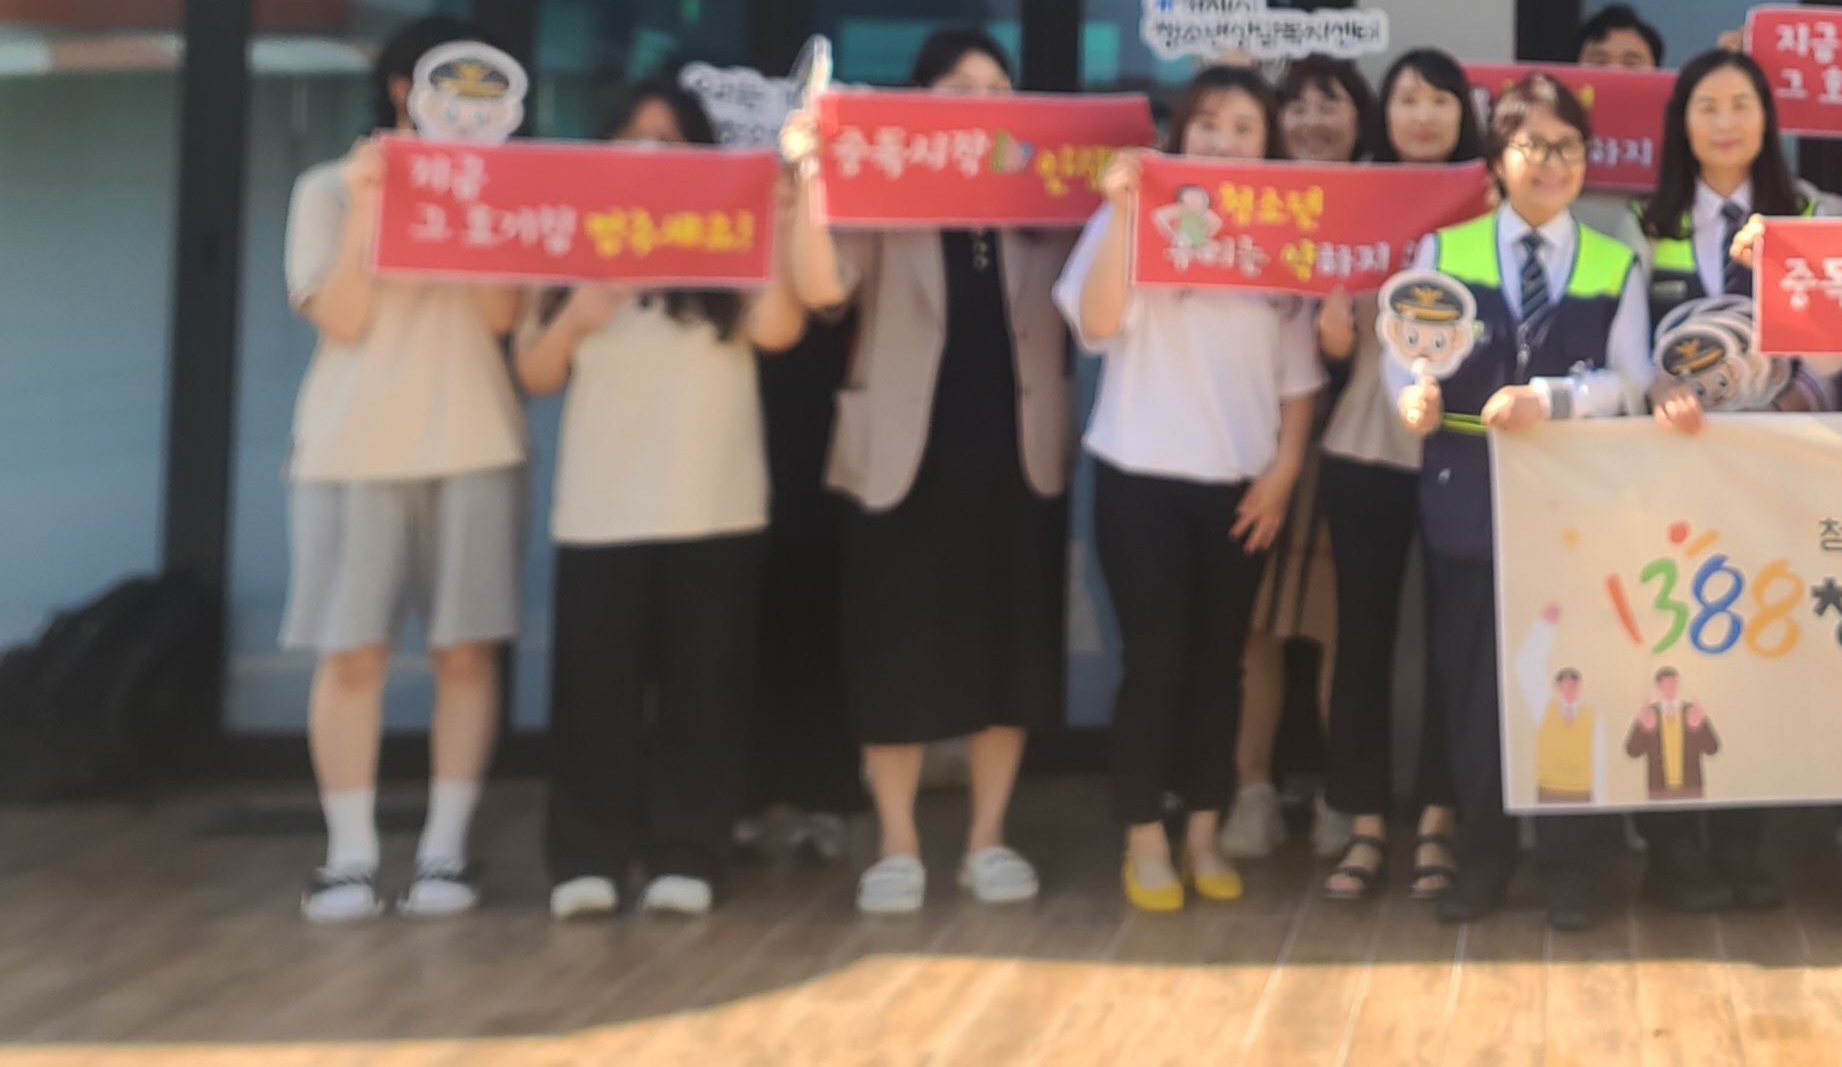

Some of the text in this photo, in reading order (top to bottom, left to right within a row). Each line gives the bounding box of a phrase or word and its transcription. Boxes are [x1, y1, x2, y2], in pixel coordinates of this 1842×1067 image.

[1775, 21, 1842, 64] 지금
[1776, 69, 1808, 99] 그
[1035, 143, 1112, 197] 인생
[1590, 136, 1653, 168] 하지
[409, 203, 451, 242] 그
[1218, 181, 1324, 230] 청소년
[1279, 239, 1391, 282] 약하지
[1604, 552, 1805, 659] 1388
